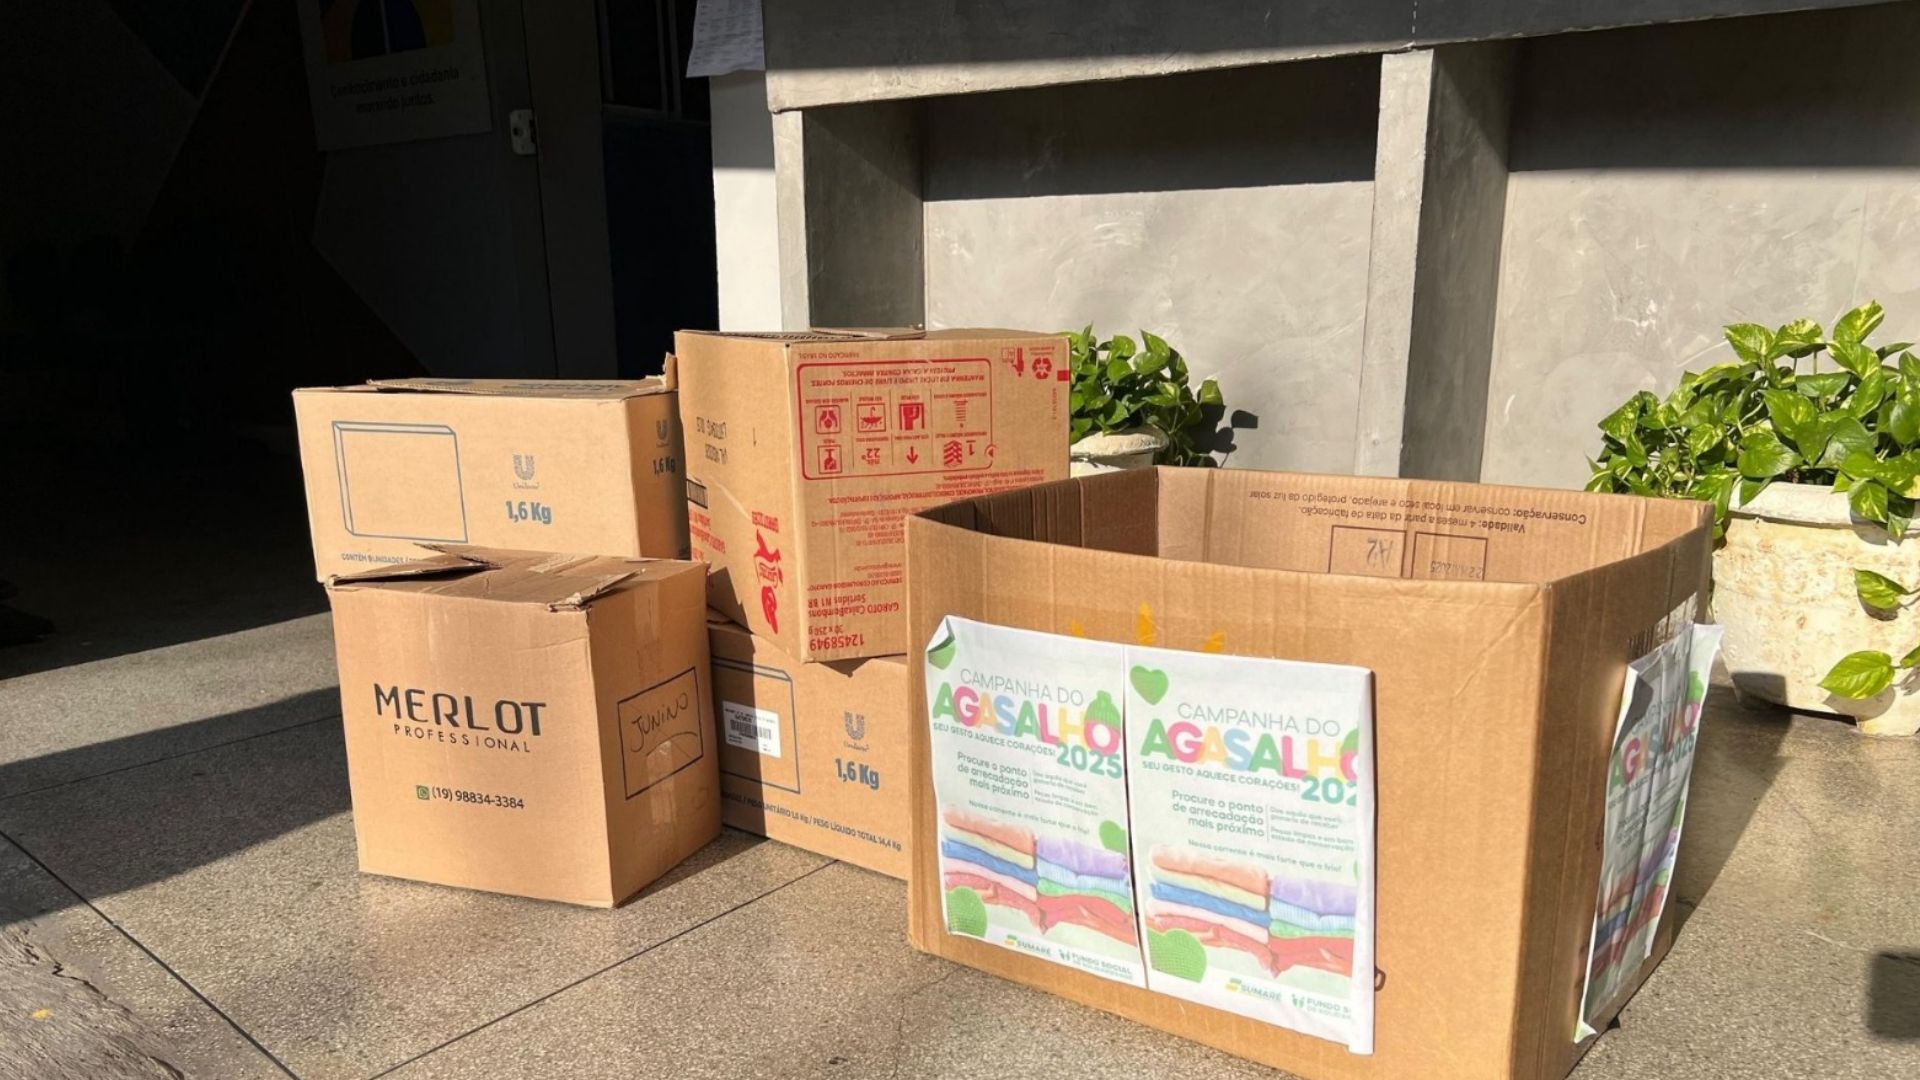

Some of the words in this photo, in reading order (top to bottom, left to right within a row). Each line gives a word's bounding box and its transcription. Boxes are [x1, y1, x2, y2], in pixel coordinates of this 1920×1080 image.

[1249, 490, 1272, 500] solar
[1274, 492, 1287, 501] luz
[1288, 493, 1300, 502] da
[1302, 491, 1347, 505] protegido
[505, 500, 528, 523] 1,6
[531, 502, 552, 525] Kg
[1351, 510, 1364, 519] de
[1422, 502, 1443, 512] local
[1446, 503, 1461, 512] em
[1462, 504, 1511, 516] conservar
[1366, 511, 1387, 521] data
[1389, 512, 1402, 521] da
[1429, 517, 1435, 525] a
[1436, 518, 1468, 528] meses
[1513, 507, 1587, 525] Conservação:
[1470, 520, 1476, 529] 4
[1479, 520, 1525, 534] Validade:
[807, 598, 818, 609] BR
[867, 602, 899, 614] GAROTO
[808, 633, 865, 652] 12458949
[960, 668, 1052, 702] CAMPANHA
[1057, 687, 1084, 707] DO
[373, 683, 547, 736] MERLOT
[932, 681, 1121, 757] AGASALHO
[1177, 702, 1300, 733] CAMPANHA
[1306, 717, 1341, 738] DO
[393, 723, 531, 753] PROFESSIONAL
[932, 722, 949, 733] SEU
[950, 724, 973, 739] GESTO
[974, 731, 1006, 748] AQUECE
[957, 751, 991, 770] Procure
[991, 762, 998, 770] o
[1000, 764, 1028, 779] ponto
[957, 763, 970, 774] de
[1056, 742, 1122, 779] 2025
[835, 758, 857, 782] 1,6
[859, 763, 880, 790] Kg
[1142, 760, 1160, 771] SEU
[1163, 763, 1194, 776] GESTO
[1196, 768, 1237, 784] AQUECE
[1238, 775, 1300, 792] CORAÇÕES!
[969, 776, 990, 790] mais
[992, 781, 1030, 800] próximo
[431, 786, 453, 801] (19)
[455, 789, 525, 809] 98834-3384
[1172, 790, 1215, 807] Procure
[1217, 799, 1226, 808] o
[1228, 801, 1264, 817] ponto
[1172, 802, 1187, 813] de
[1189, 805, 1264, 827] arrecadação
[1188, 817, 1215, 830] mais
[1216, 821, 1265, 838] próximo
[1343, 1005, 1352, 1014] S
